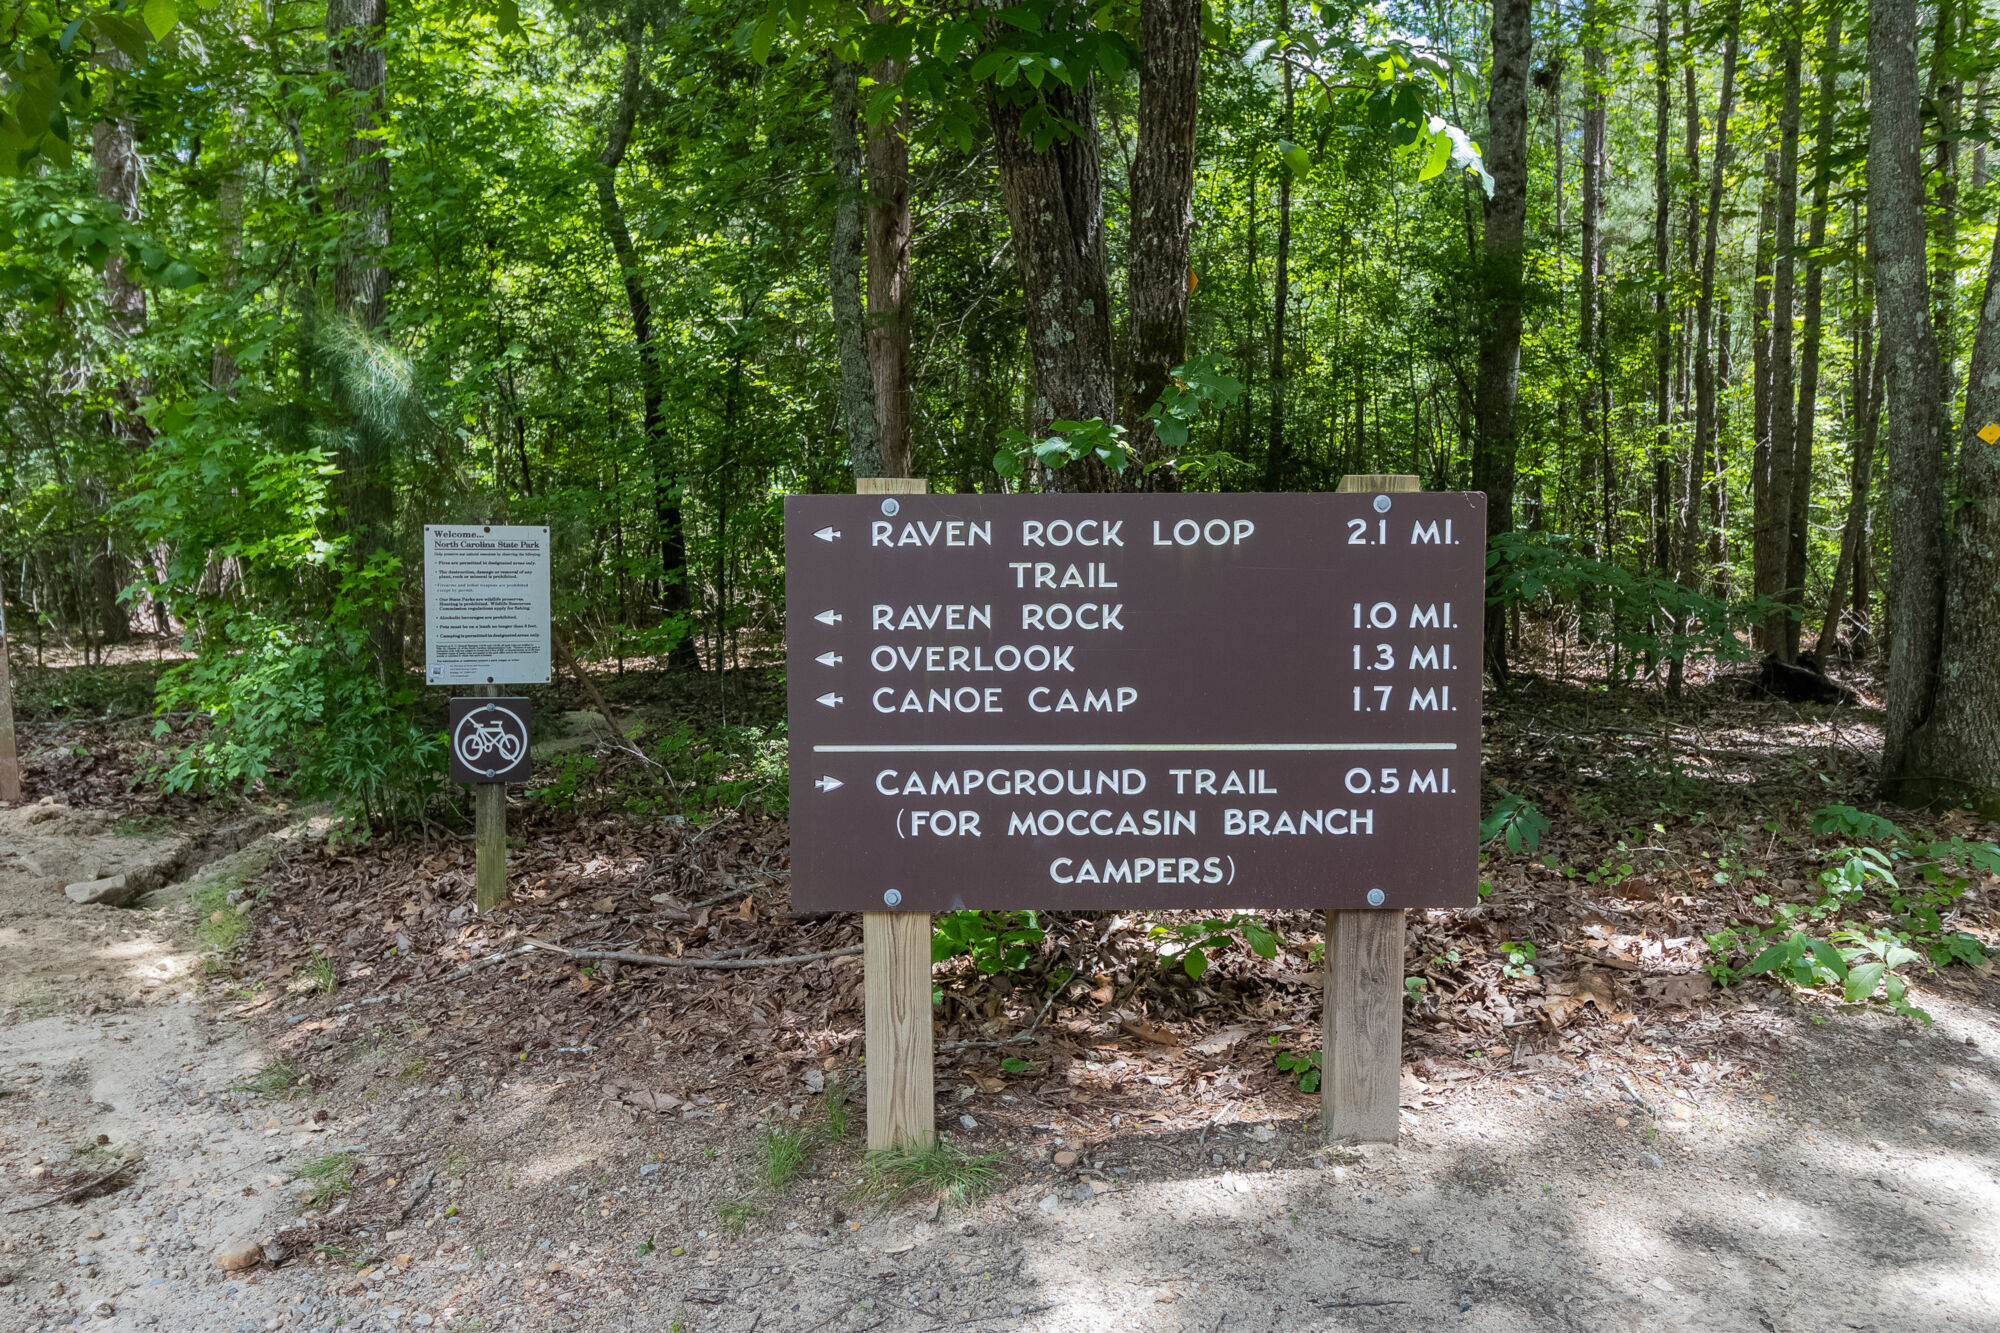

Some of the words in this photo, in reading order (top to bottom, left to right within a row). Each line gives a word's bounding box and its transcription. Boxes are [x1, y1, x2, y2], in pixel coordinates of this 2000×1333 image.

[434, 530, 484, 538] Welcome...
[434, 540, 459, 548] North
[460, 540, 496, 548] Carolina
[497, 540, 519, 548] State
[520, 540, 540, 548] Park
[871, 520, 992, 548] RAVEN
[1022, 519, 1125, 548] ROCK
[1153, 518, 1255, 546] LOOP
[1347, 518, 1389, 545] 2.1
[1410, 518, 1461, 545] MI.
[1008, 562, 1118, 590] TRAIL
[872, 603, 991, 632] RAVEN
[1022, 602, 1125, 631] ROCK
[1352, 601, 1398, 629] 1.0
[1409, 602, 1459, 629] MI.
[870, 644, 1076, 673] OVERLOOK
[1352, 643, 1396, 671] 1.3
[1408, 644, 1459, 670] MI.
[872, 686, 1005, 714] CANOE
[1027, 686, 1138, 713] CAMP
[1352, 685, 1394, 712] 1.7
[1408, 685, 1458, 712] MI.
[875, 768, 1148, 796] CAMPGROUND
[1168, 768, 1278, 796] TRAIL
[1344, 767, 1399, 794] 0.5
[1407, 767, 1457, 794] MI.
[895, 808, 983, 839] (FOR
[1007, 808, 1197, 837] MOCCASIN
[1223, 808, 1374, 836] BRANCH
[1049, 855, 1236, 886] CAMPERS)
